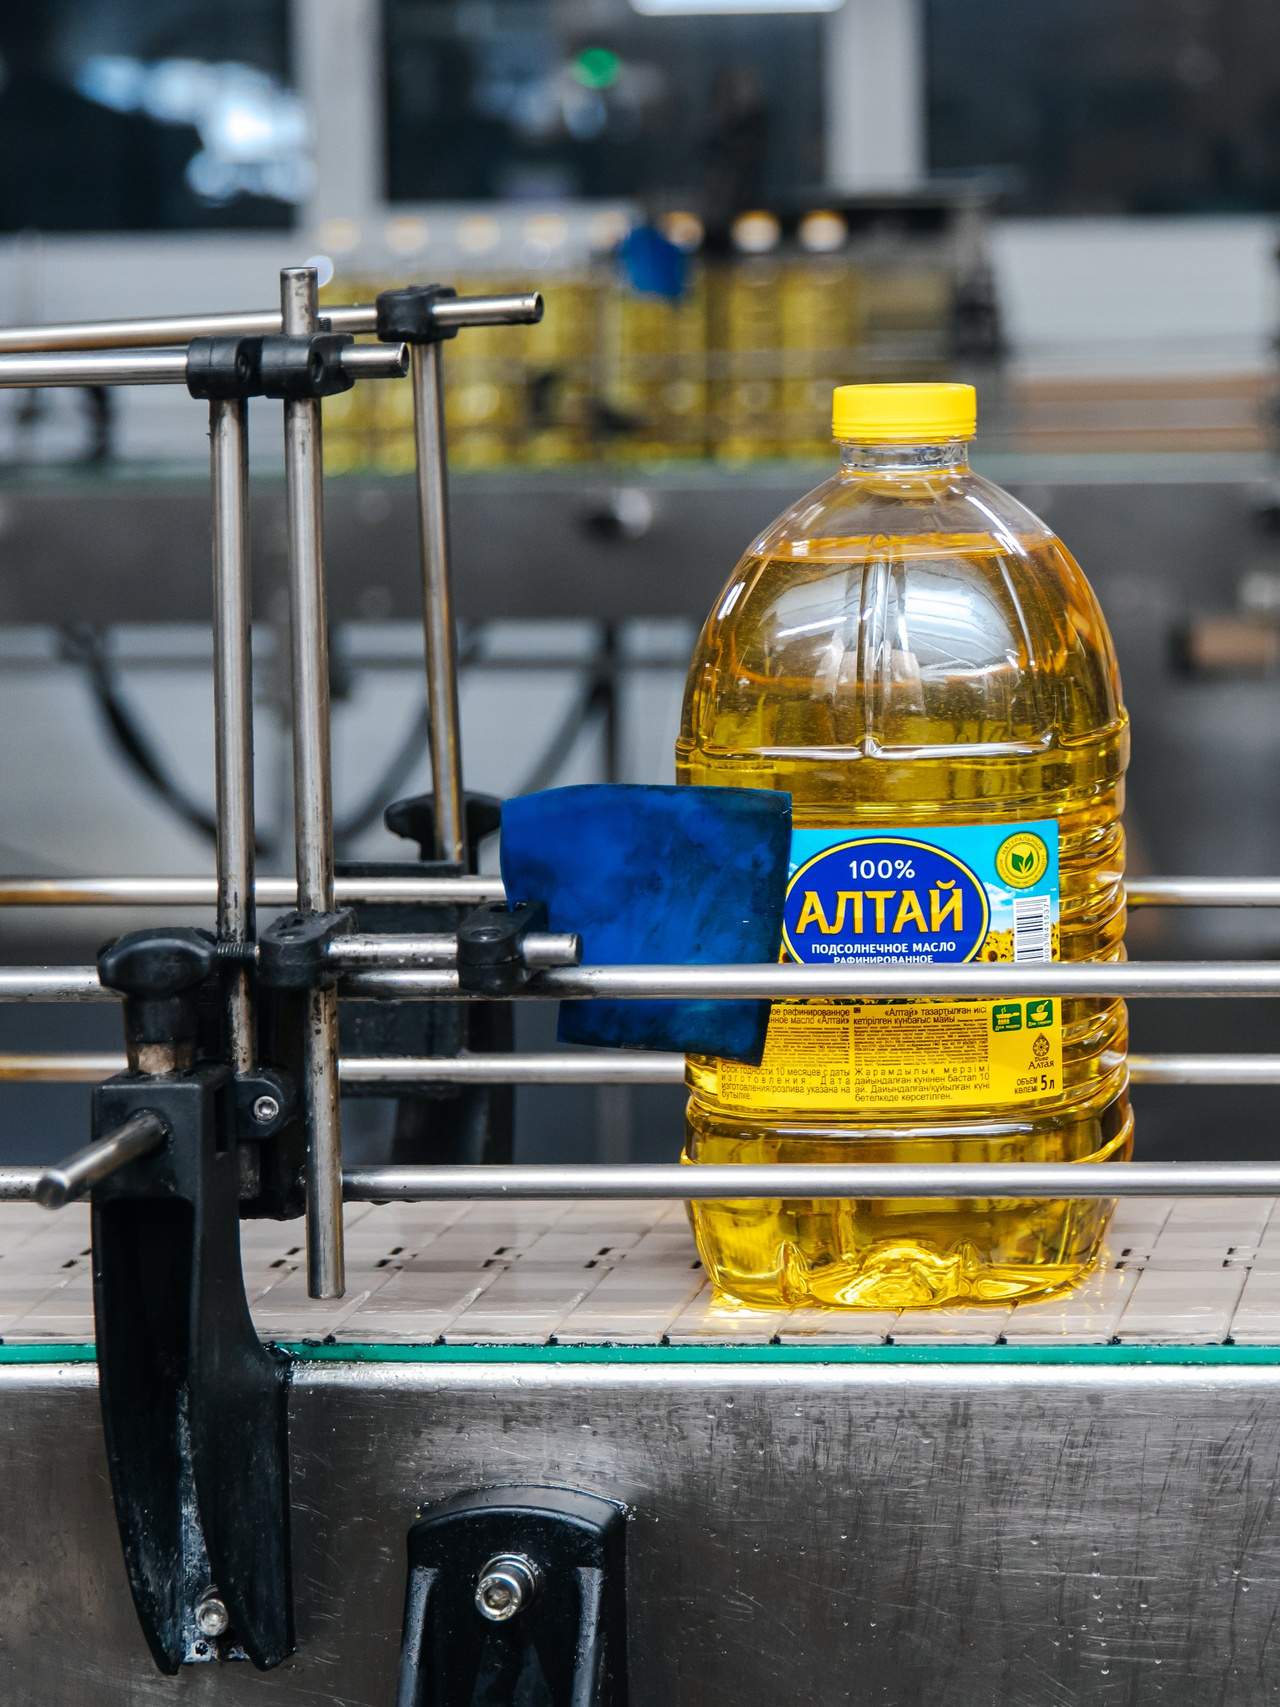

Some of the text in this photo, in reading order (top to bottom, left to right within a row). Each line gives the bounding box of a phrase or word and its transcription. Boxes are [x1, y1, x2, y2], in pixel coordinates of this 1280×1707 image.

[849, 860, 915, 878] 100%
[795, 880, 962, 934] АЛТАЙ
[812, 942, 955, 955] ПОДСОЛНЕЧНОЕ МАСЛО
[834, 955, 933, 963] РАФИНИРОВАННОЕ
[783, 1007, 850, 1017] рафинированное
[721, 1064, 738, 1074] Срок
[740, 1067, 773, 1075] годности
[776, 1067, 785, 1076] 10
[788, 1069, 821, 1077] месяцев
[1028, 1061, 1054, 1070] Алтая
[821, 1076, 850, 1085] Дата
[948, 1074, 976, 1082] бастап
[1017, 1076, 1037, 1085] ОБЪЕМ
[1041, 1074, 1047, 1090] 5
[722, 1083, 804, 1094] изготовления/розлива
[807, 1086, 838, 1095] указана
[722, 1091, 752, 1100] бутылке.
